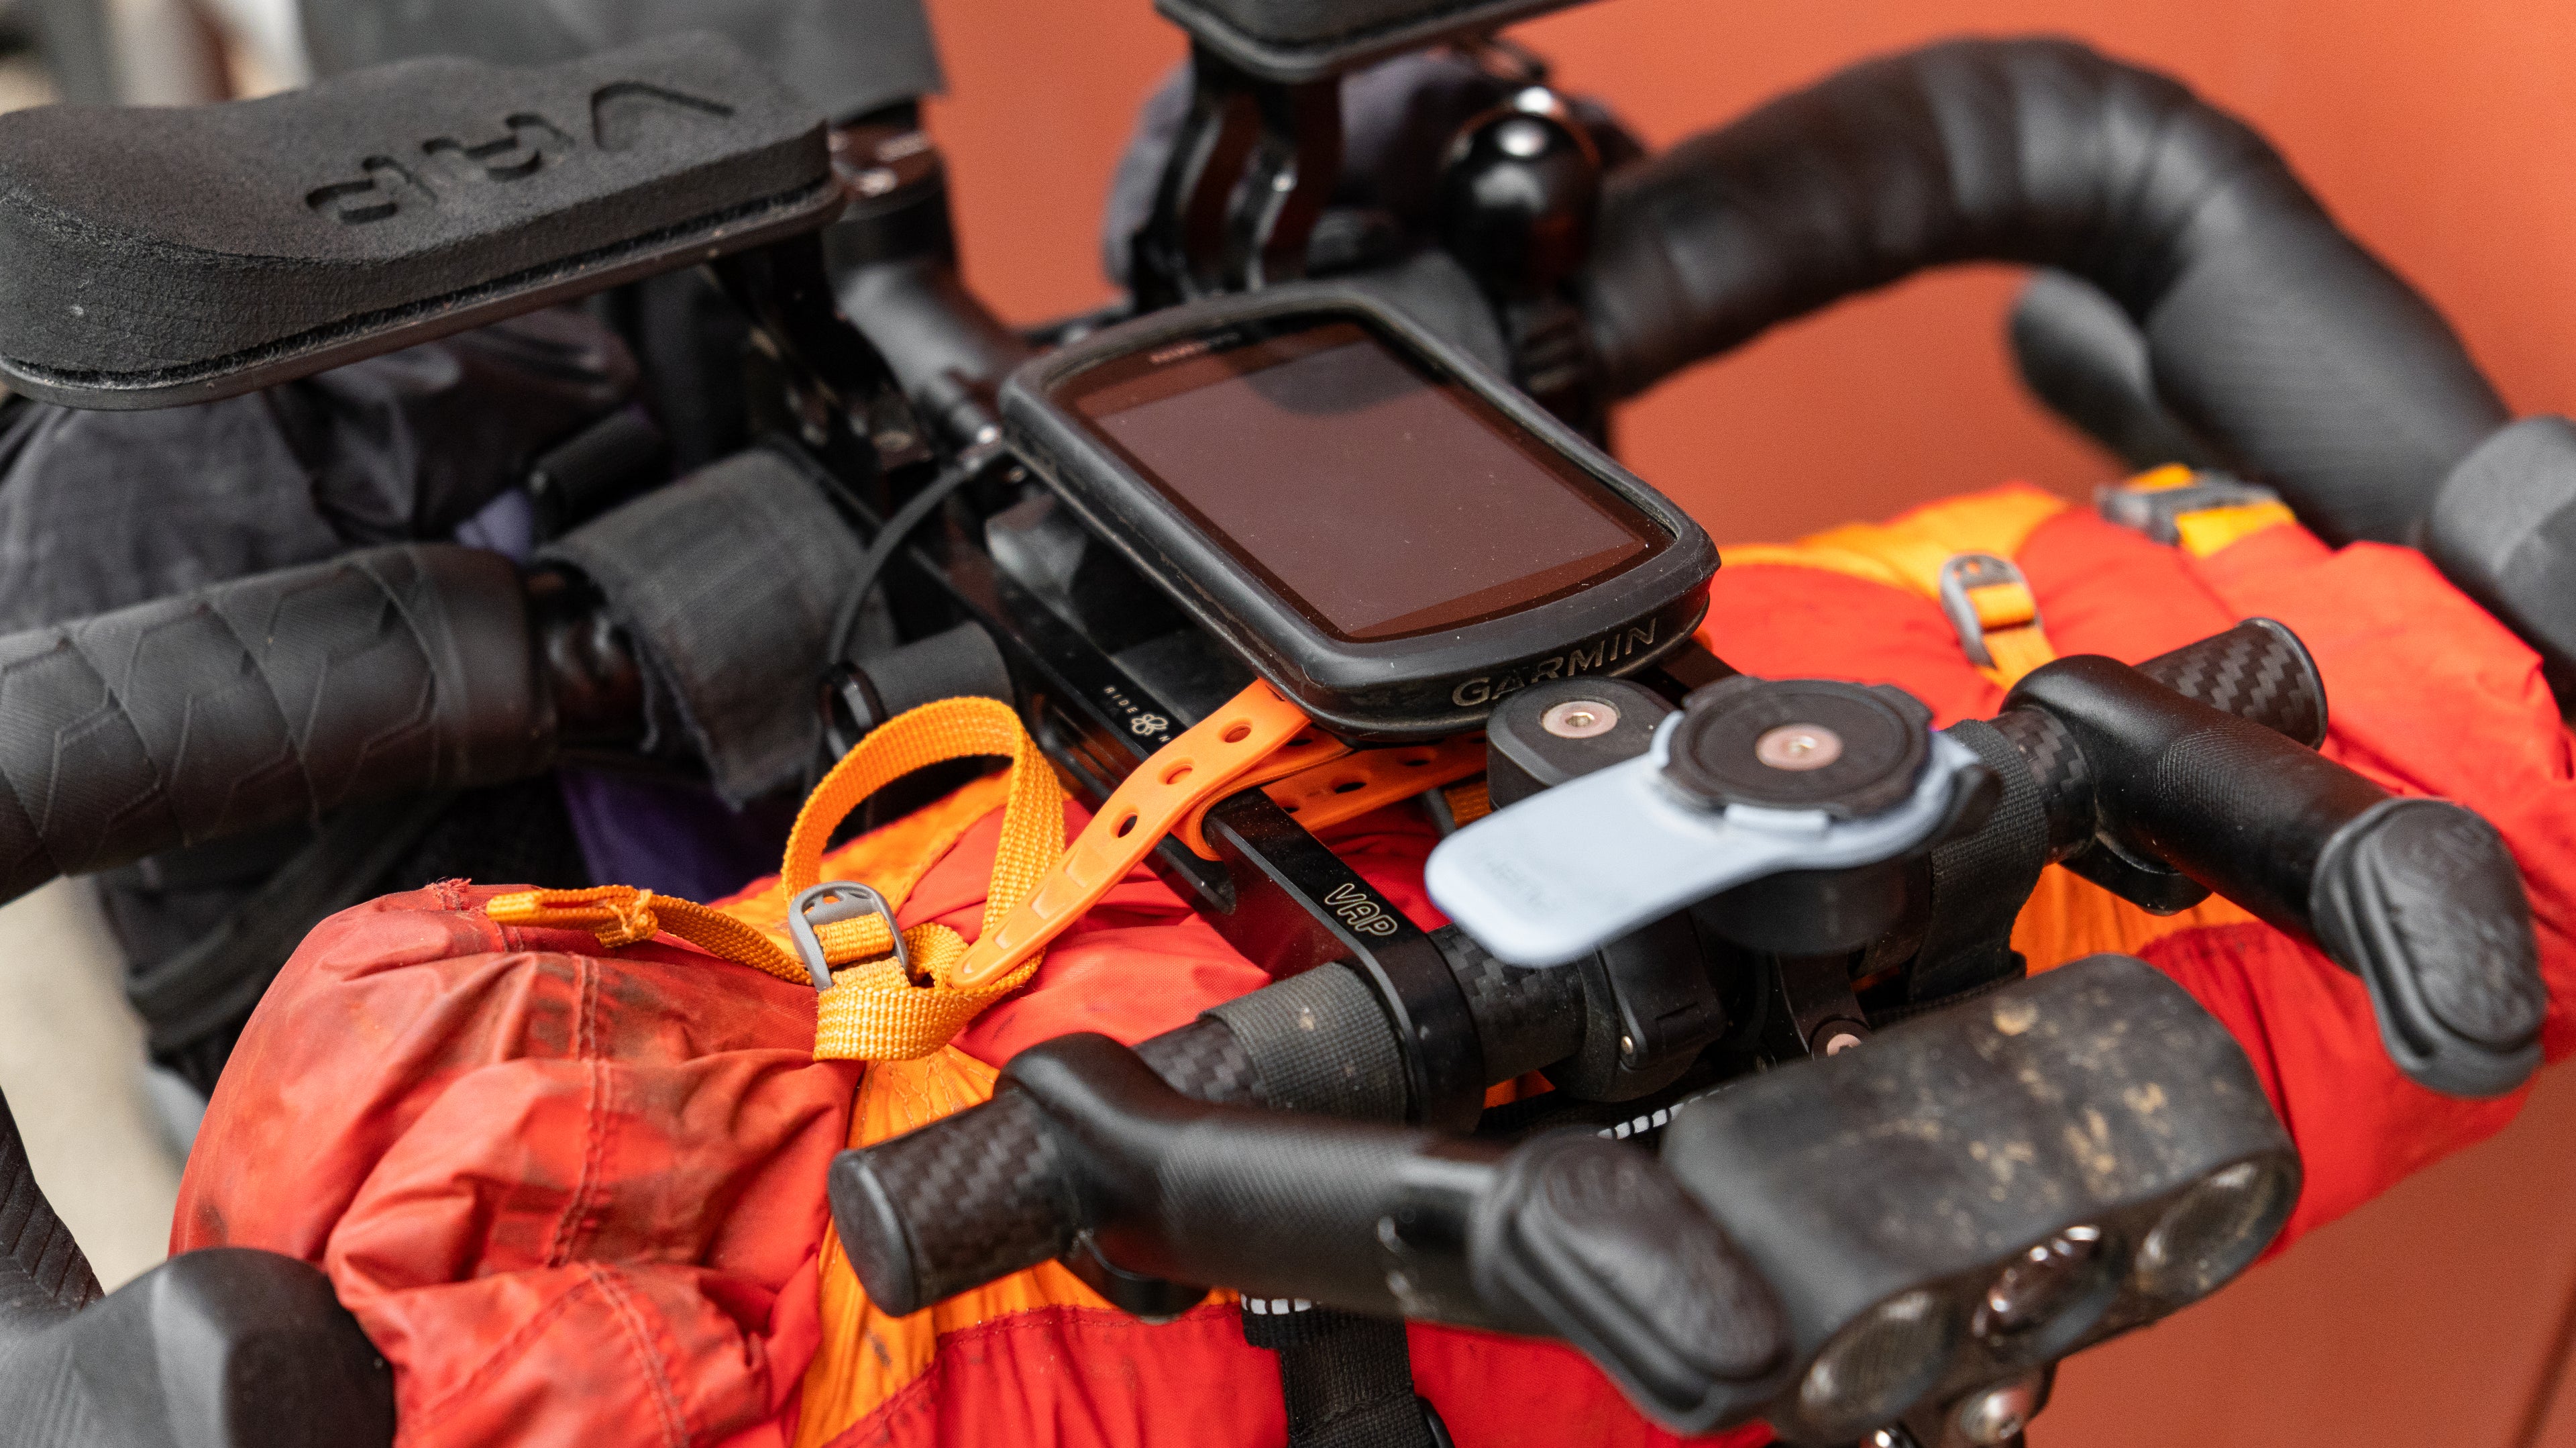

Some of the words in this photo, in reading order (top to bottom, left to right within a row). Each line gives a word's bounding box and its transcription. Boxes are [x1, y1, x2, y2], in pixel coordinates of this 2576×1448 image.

[1452, 616, 1657, 707] GARMIN
[1104, 686, 1138, 713] RIDE
[1324, 882, 1398, 936] VAP
